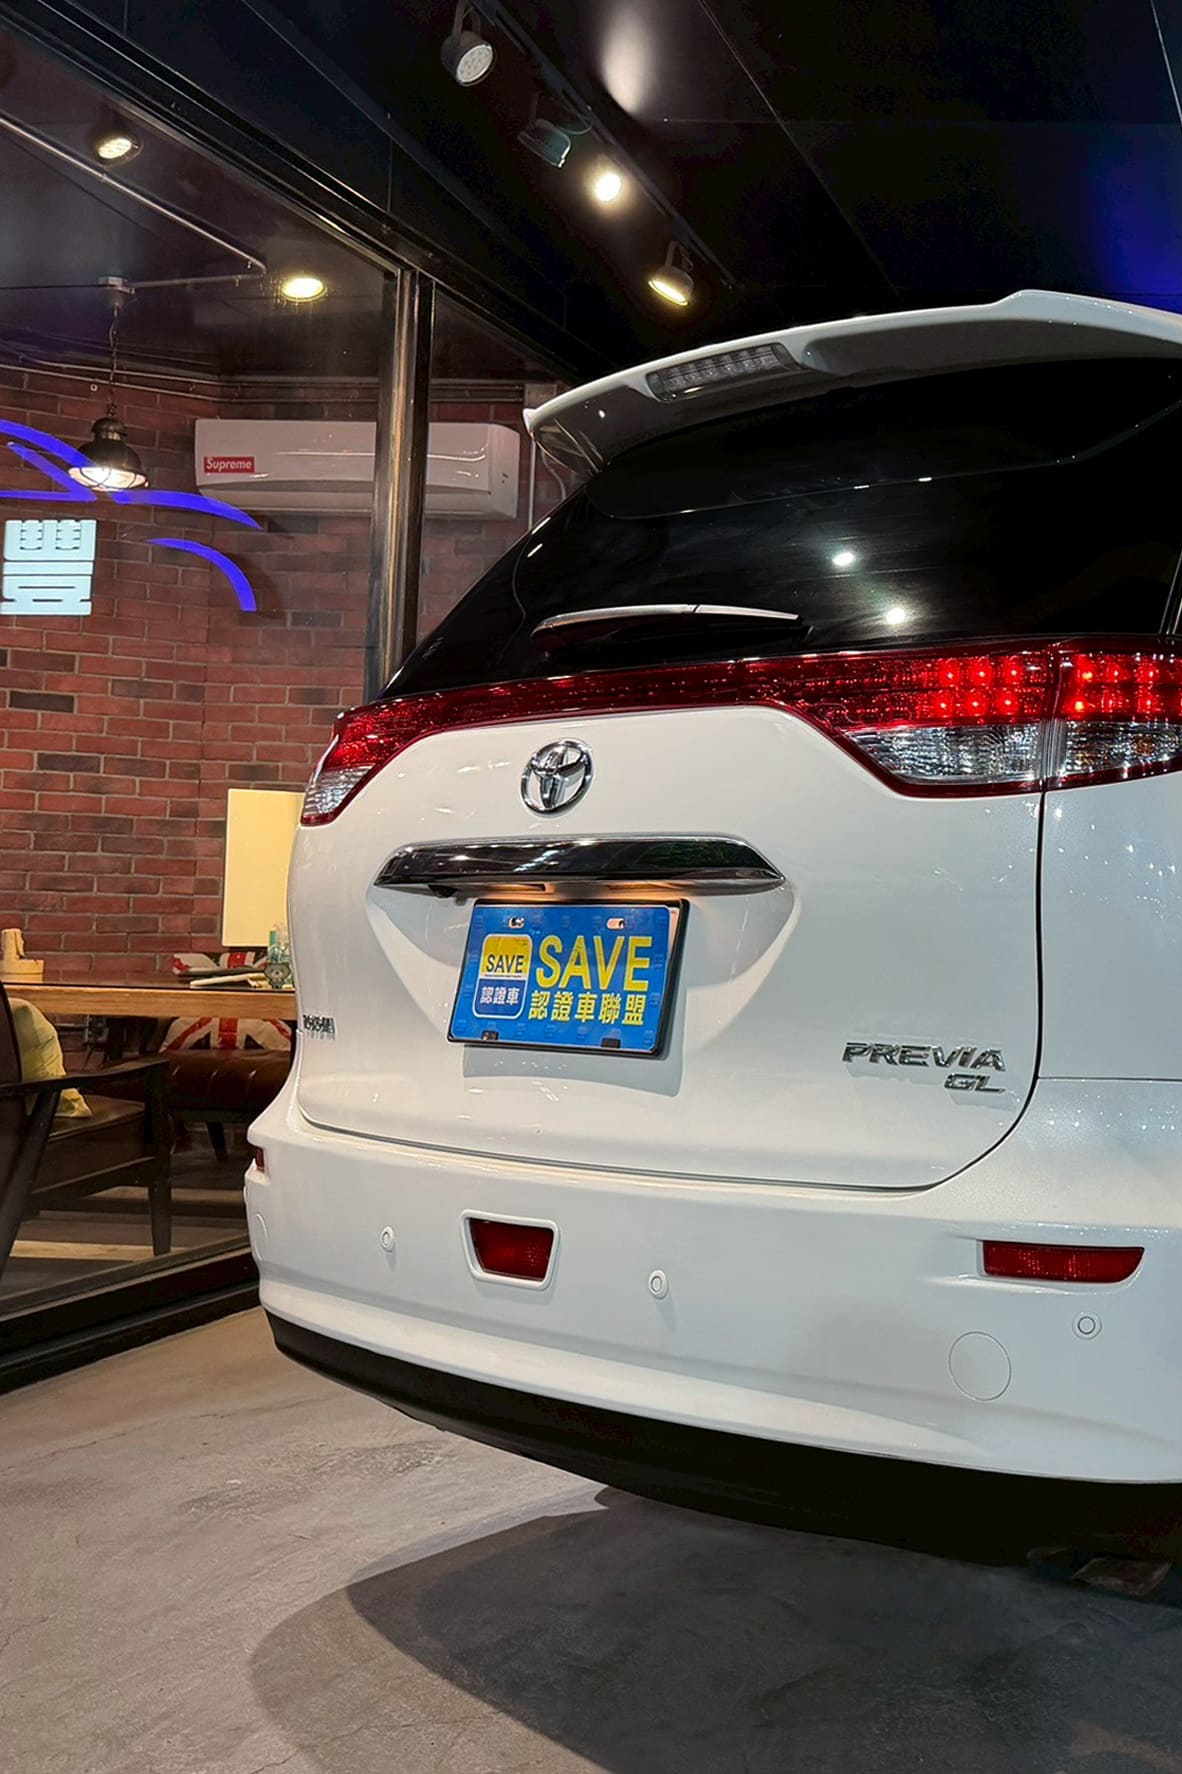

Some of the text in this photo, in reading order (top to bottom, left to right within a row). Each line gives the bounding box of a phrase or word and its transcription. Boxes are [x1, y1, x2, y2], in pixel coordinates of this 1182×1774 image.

[206, 457, 252, 472] Supreme
[486, 953, 525, 973] SAVE
[536, 935, 652, 992] SAVE
[480, 985, 520, 1006] 認證車
[528, 990, 647, 1026] 認證車聯盟
[842, 1042, 1006, 1072] PREVIA
[944, 1073, 1006, 1094] GL
